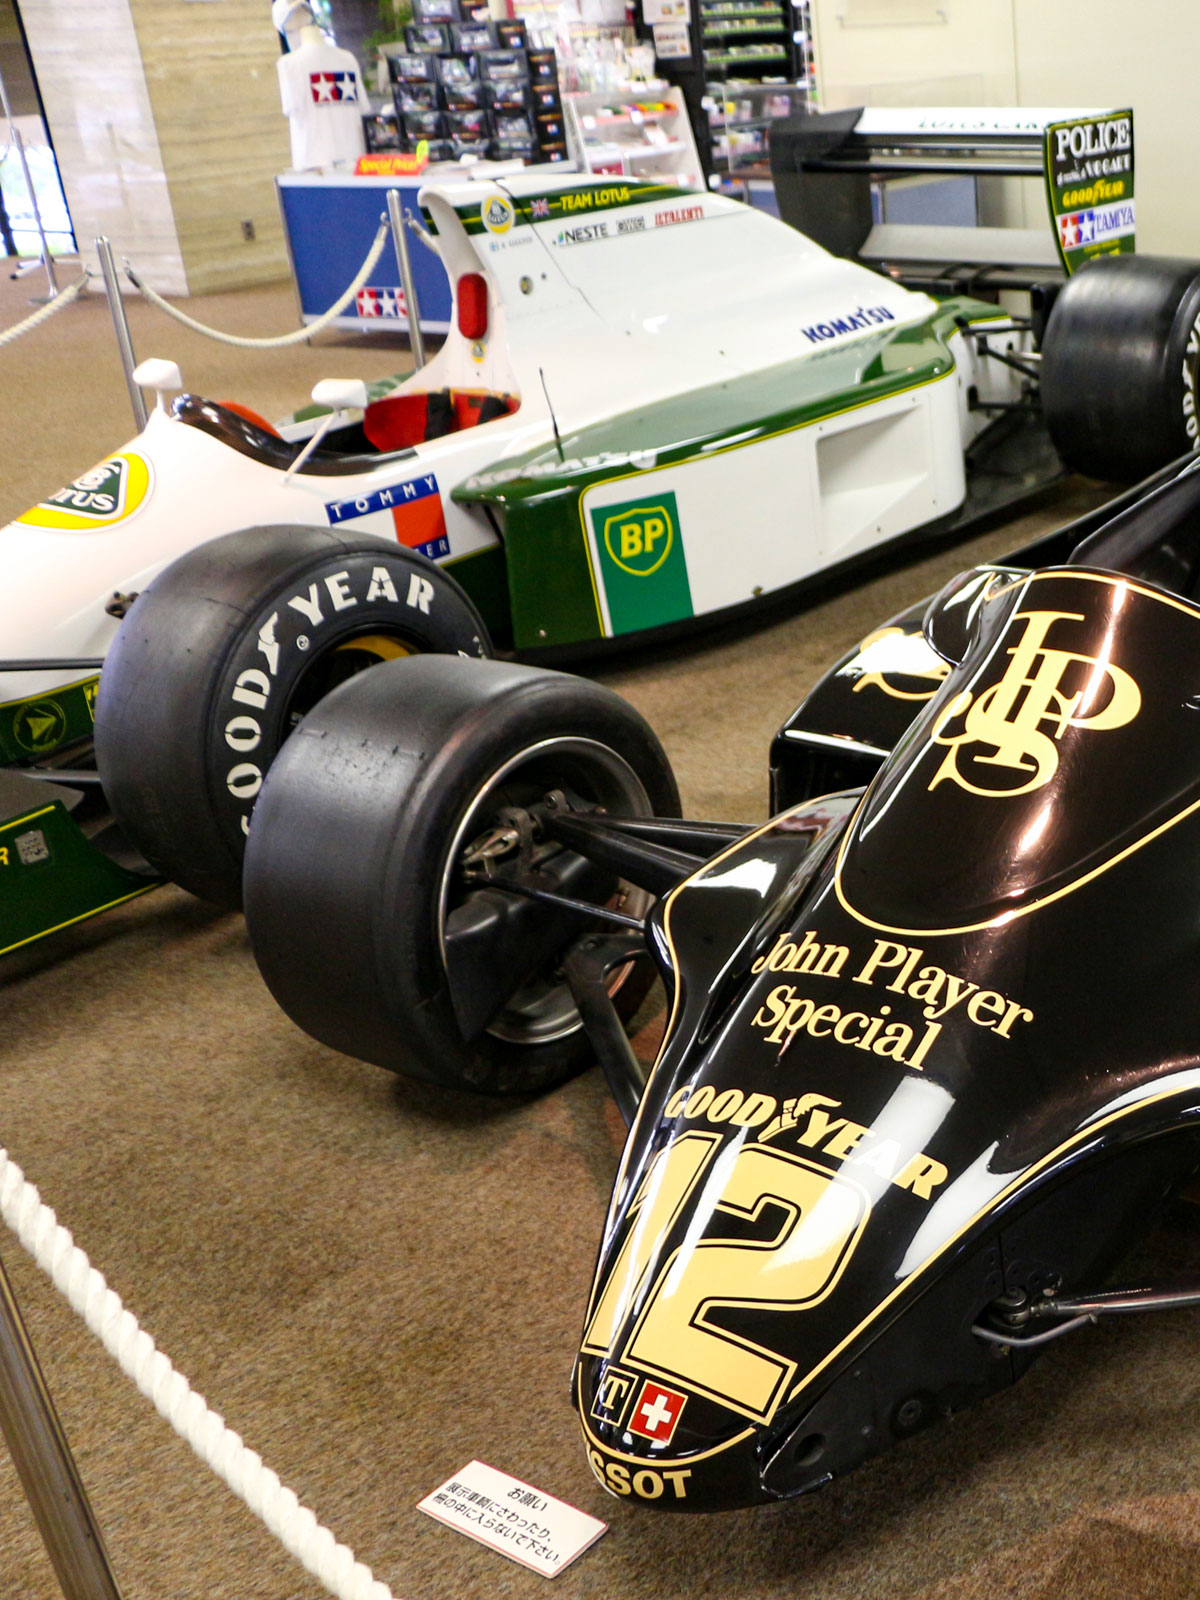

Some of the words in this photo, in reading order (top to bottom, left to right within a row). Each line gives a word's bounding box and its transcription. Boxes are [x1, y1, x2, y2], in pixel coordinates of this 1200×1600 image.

[1055, 118, 1130, 162] POLICE
[560, 193, 594, 211] TEAM
[595, 186, 630, 205] LOTUS
[565, 222, 609, 243] NESTE
[1095, 206, 1135, 234] TAMIYA
[801, 305, 895, 343] KOMATSU
[331, 476, 434, 518] TOMMY
[620, 517, 665, 559] BP
[751, 930, 850, 978] John
[852, 938, 1034, 1039] Player
[751, 984, 943, 1071] Special
[580, 1129, 798, 1427] 12
[507, 1487, 548, 1512] お願い
